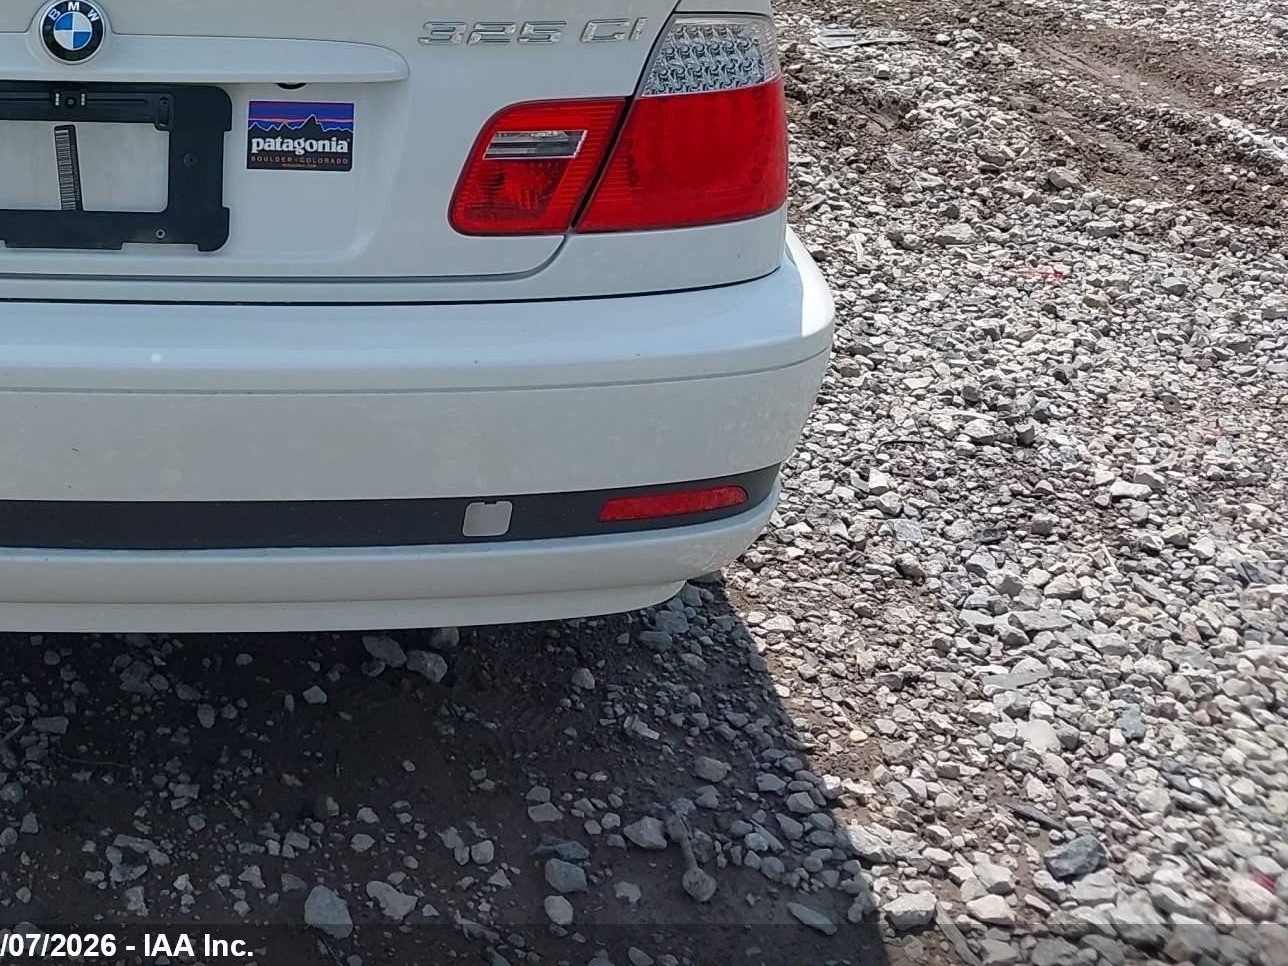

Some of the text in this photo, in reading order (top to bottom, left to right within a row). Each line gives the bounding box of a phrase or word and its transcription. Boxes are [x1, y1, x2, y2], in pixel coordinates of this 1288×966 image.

[47, 0, 100, 23] BMW
[417, 20, 567, 45] 325
[251, 136, 349, 155] patagonia
